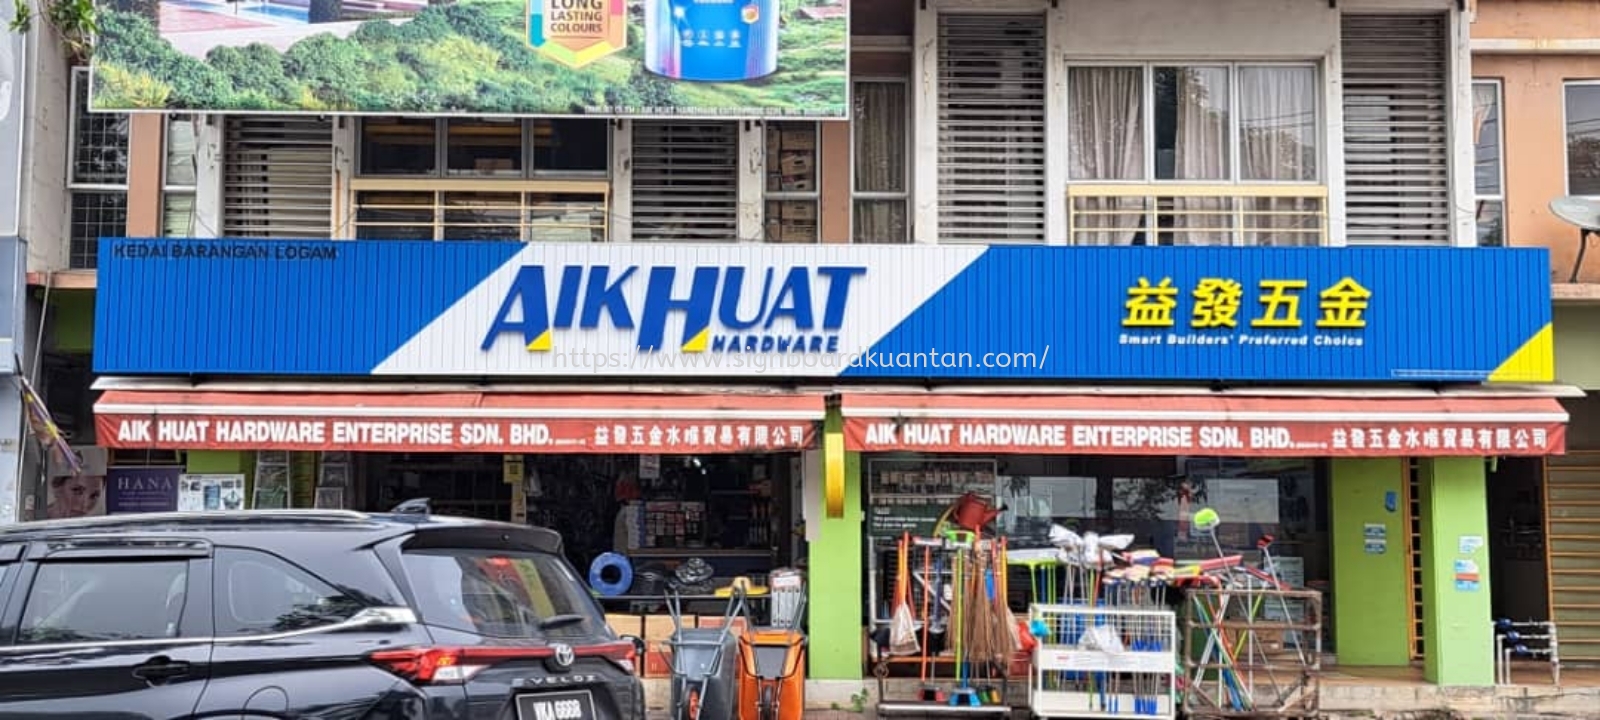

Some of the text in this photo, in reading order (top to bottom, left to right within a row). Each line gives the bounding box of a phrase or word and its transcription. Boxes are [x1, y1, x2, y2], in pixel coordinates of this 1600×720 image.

[551, 0, 603, 9] LONG
[550, 11, 603, 21] LASTING
[550, 23, 603, 33] COLOURS
[113, 243, 337, 260] KEDAI BARANGAN LOGAM
[1120, 276, 1372, 327] 益發五金
[711, 334, 839, 353] HARDWARE
[1119, 333, 1364, 346] Smart Builders' Preferred Choice
[117, 420, 151, 442] AIK
[157, 420, 210, 442] HUAT
[215, 421, 325, 443] HARDWARE
[332, 422, 454, 444] ENTERPRISE
[460, 423, 504, 445] SDN.
[865, 423, 897, 445] AIK
[903, 423, 954, 445] HUAT
[959, 424, 1066, 446] HARDWARE
[1072, 425, 1193, 448] ENTERPRISE
[1198, 426, 1243, 448] SDN.
[118, 476, 172, 490] HANA
